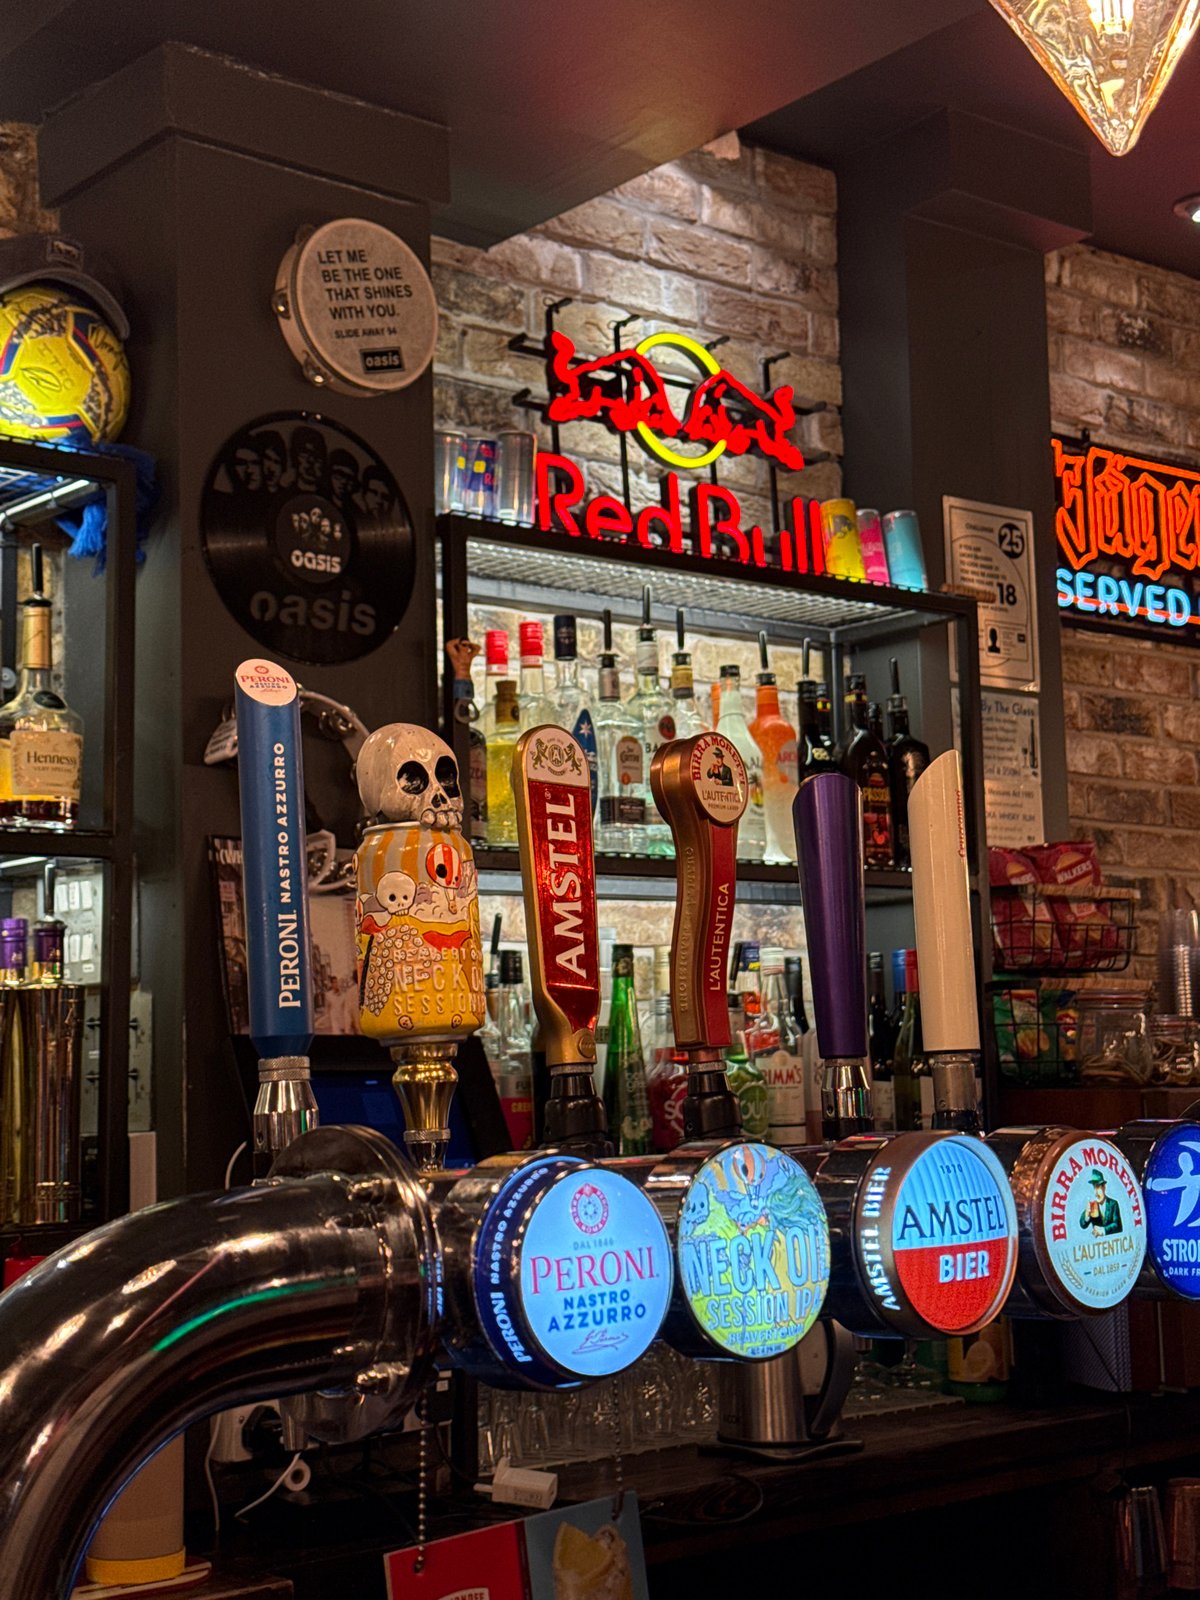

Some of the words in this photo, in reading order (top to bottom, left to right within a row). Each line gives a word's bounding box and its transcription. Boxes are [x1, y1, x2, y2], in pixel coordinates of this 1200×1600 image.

[317, 250, 342, 264] LET
[346, 249, 367, 263] ME
[321, 269, 341, 283] BE
[344, 267, 371, 281] THE
[374, 266, 403, 280] ONE
[325, 287, 360, 301] THAT
[364, 284, 413, 300] SHINES
[329, 305, 365, 320] WITH
[334, 329, 360, 339] SLIDE
[362, 327, 386, 336] AWAY
[365, 352, 400, 368] oasis
[535, 451, 683, 557] Red
[692, 483, 825, 577] Bull
[1001, 527, 1023, 554] 25
[291, 549, 342, 574] oasis
[997, 582, 1018, 606] 18
[1055, 567, 1191, 627] SERVED
[250, 590, 377, 636] oasis
[240, 674, 291, 684] PERONI
[691, 737, 710, 782] BIRRA
[709, 735, 747, 786] MORETTI
[273, 742, 289, 828] AZZURRO
[278, 831, 291, 903] NASTRO
[545, 793, 587, 980] AMSTEL
[710, 883, 729, 991] L'AUTENTICA
[278, 911, 302, 1008] PERONI
[393, 963, 467, 994] NECK
[393, 990, 477, 1016] SESSION
[940, 1163, 963, 1175] 1870
[503, 1167, 549, 1218] AZZURRO
[861, 1166, 892, 1218] BIER
[1050, 1156, 1083, 1242] BIRRA
[1082, 1147, 1143, 1228] MORETTI
[897, 1195, 1005, 1241] AMSTEL
[490, 1219, 508, 1286] NASTRO
[573, 1241, 590, 1251] DAL
[682, 1229, 781, 1299] NECK
[785, 1223, 830, 1286] OIL
[1073, 1235, 1134, 1263] L'AUTENTICA
[1162, 1238, 1200, 1263] STRO
[530, 1246, 656, 1295] PERONI
[861, 1223, 901, 1311] AMSTEL
[938, 1250, 990, 1284] BIER
[1093, 1266, 1105, 1276] DAL
[1169, 1266, 1189, 1277] DARK
[564, 1288, 630, 1311] NASTRO
[706, 1290, 789, 1331] SESSION
[795, 1284, 822, 1320] IPA
[490, 1291, 533, 1363] PERONI
[547, 1302, 647, 1333] AZZURRO
